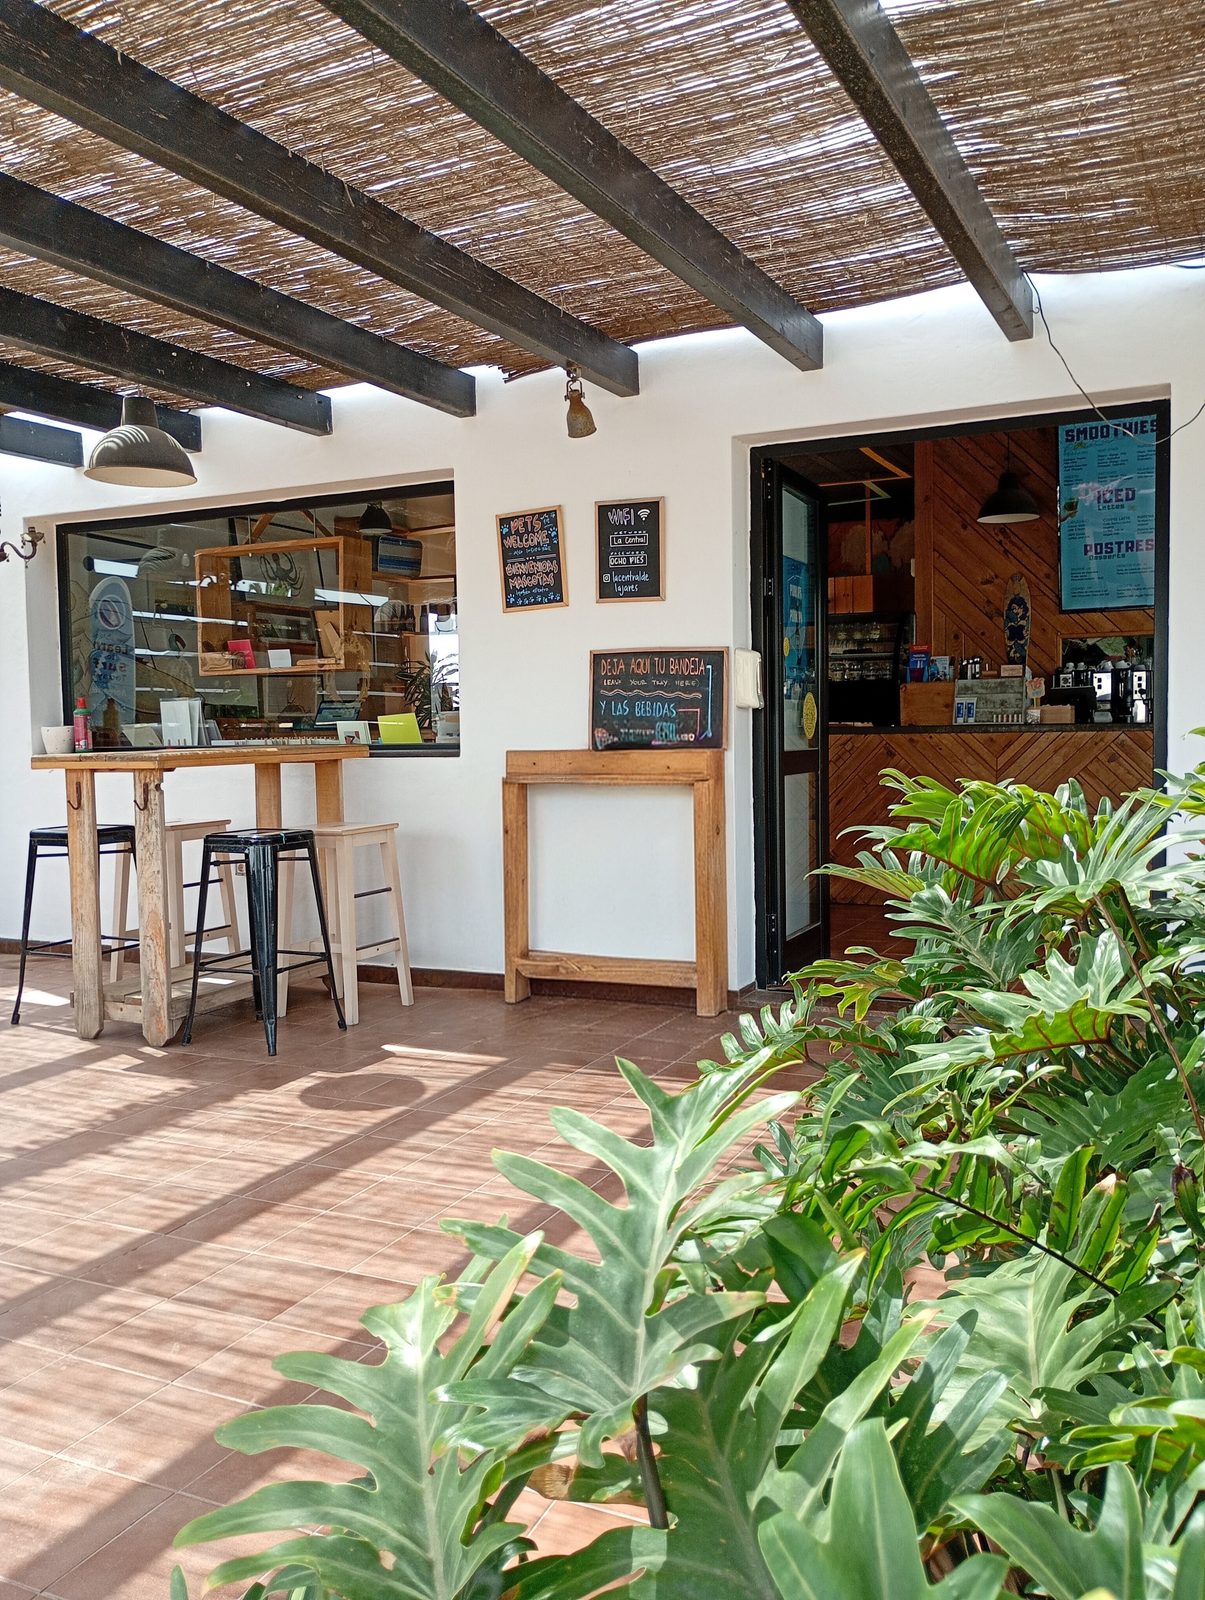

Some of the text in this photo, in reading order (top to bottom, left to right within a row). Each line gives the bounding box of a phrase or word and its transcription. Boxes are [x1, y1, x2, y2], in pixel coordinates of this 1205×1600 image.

[1065, 420, 1157, 442] SMOOTHIES
[1097, 487, 1136, 504] ICED
[510, 514, 541, 534] PETS
[503, 530, 549, 549] WELCOME
[625, 535, 646, 544] Central
[1084, 538, 1154, 556] POSTRES
[610, 555, 644, 565] OCHO PIES
[509, 572, 554, 590] MASCOTAS
[615, 583, 638, 596] lajares
[601, 658, 625, 675] DEJA
[654, 657, 666, 674] TU
[669, 657, 705, 675] BANDEJA
[600, 700, 677, 718] Y LAS BEBIDAS
